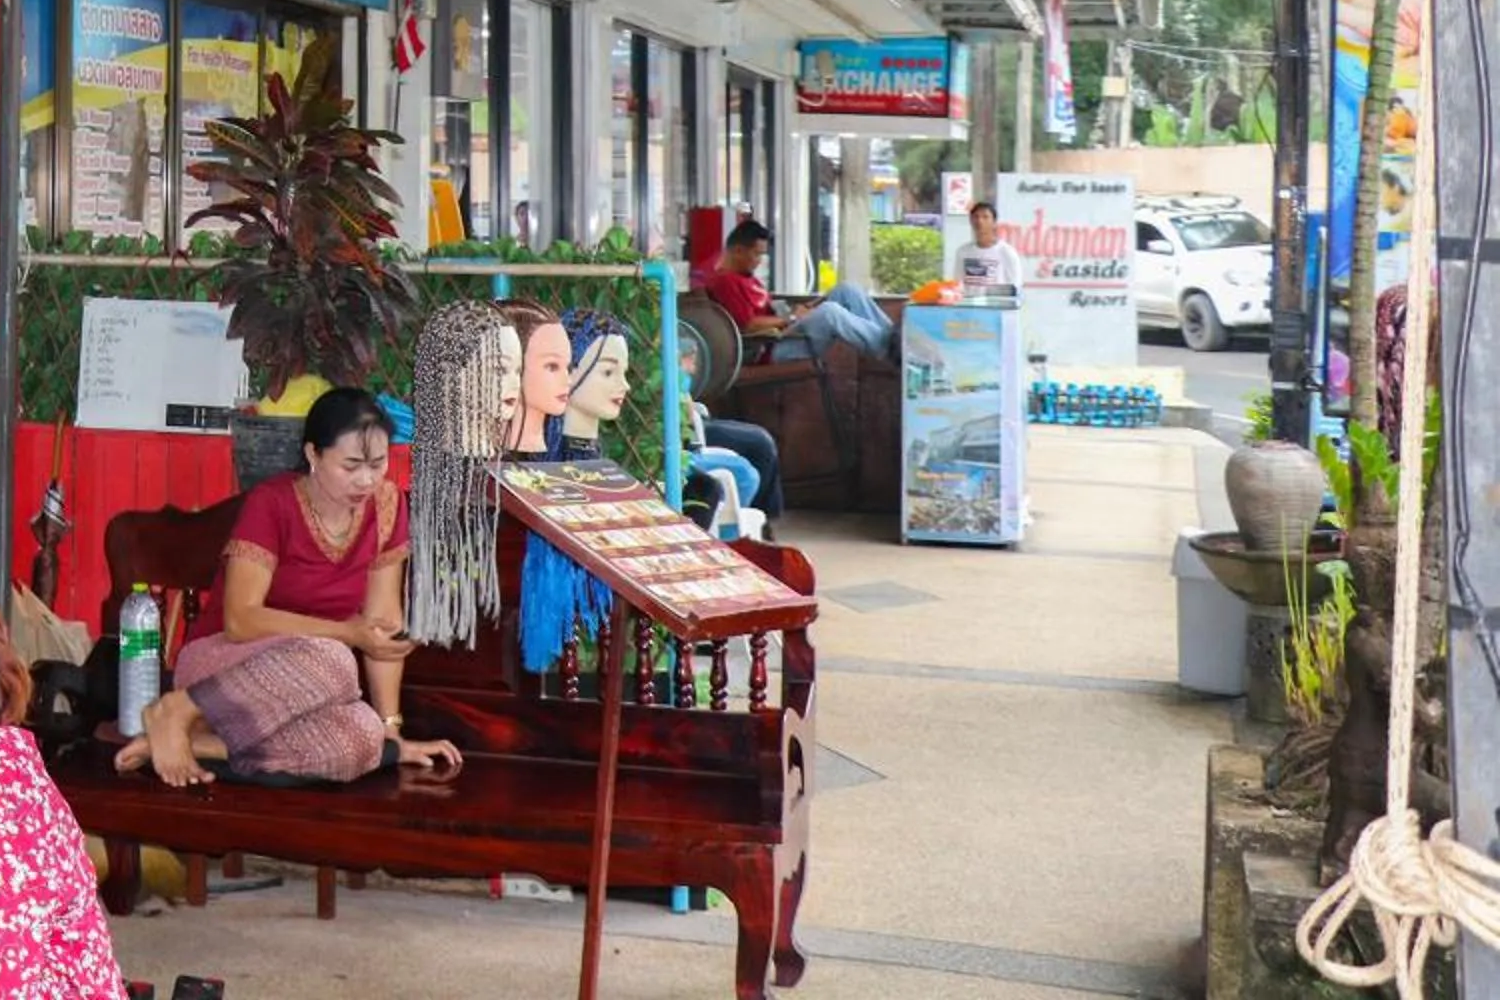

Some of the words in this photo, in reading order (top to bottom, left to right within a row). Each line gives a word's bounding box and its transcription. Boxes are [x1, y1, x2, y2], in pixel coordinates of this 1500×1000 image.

[996, 207, 1127, 260] ndaman
[1035, 259, 1129, 282] Seaside
[1068, 289, 1129, 309] Resort
